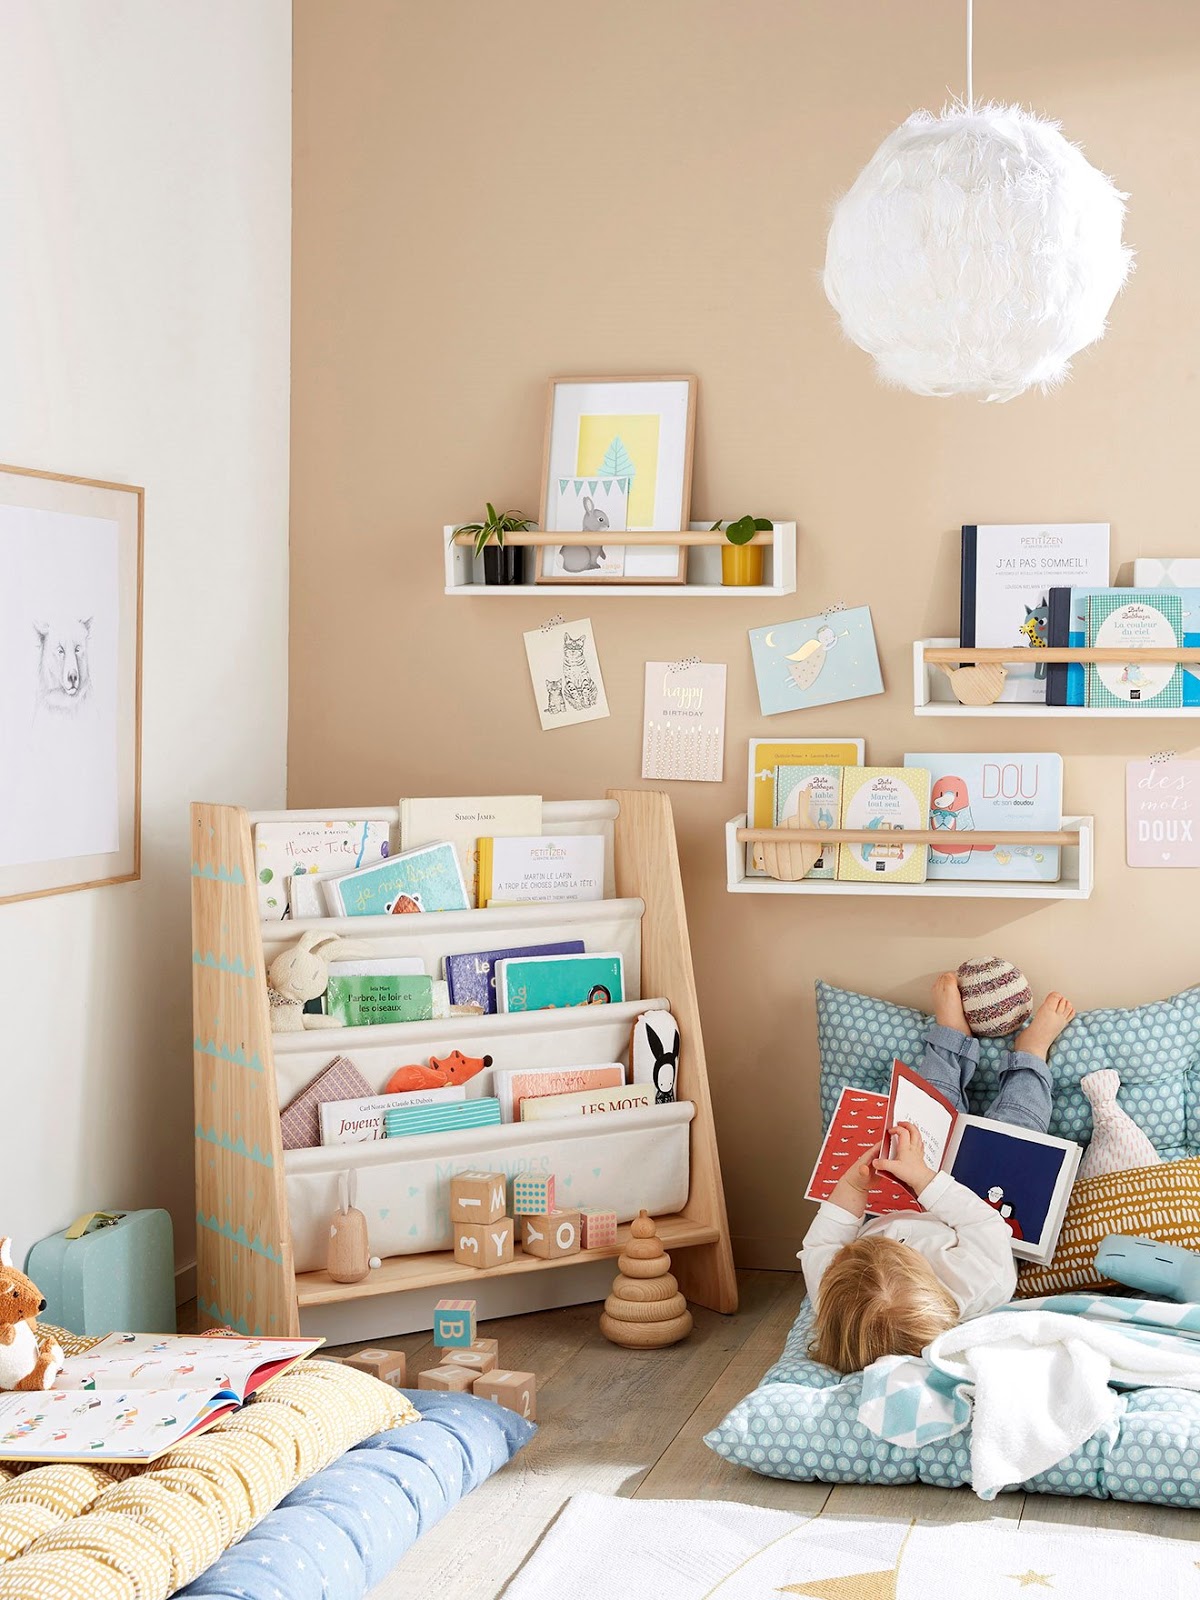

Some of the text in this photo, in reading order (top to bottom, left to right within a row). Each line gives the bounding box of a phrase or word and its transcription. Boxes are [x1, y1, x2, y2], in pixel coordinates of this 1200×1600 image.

[996, 559, 1016, 568] J'AI
[1019, 559, 1037, 568] PAS
[663, 671, 704, 710] happy
[983, 764, 1039, 798] DOU
[1138, 768, 1192, 790] des
[1140, 795, 1192, 810] mots
[1139, 820, 1193, 842] DOUX
[530, 881, 552, 889] CHOSES
[475, 958, 490, 973] Le
[371, 1004, 401, 1012] oiseaux
[581, 1097, 648, 1115] LES MOTS
[339, 1118, 380, 1135] Joyeux
[491, 1230, 509, 1257] Y
[439, 1319, 464, 1339] B
[521, 1390, 531, 1418] 2
